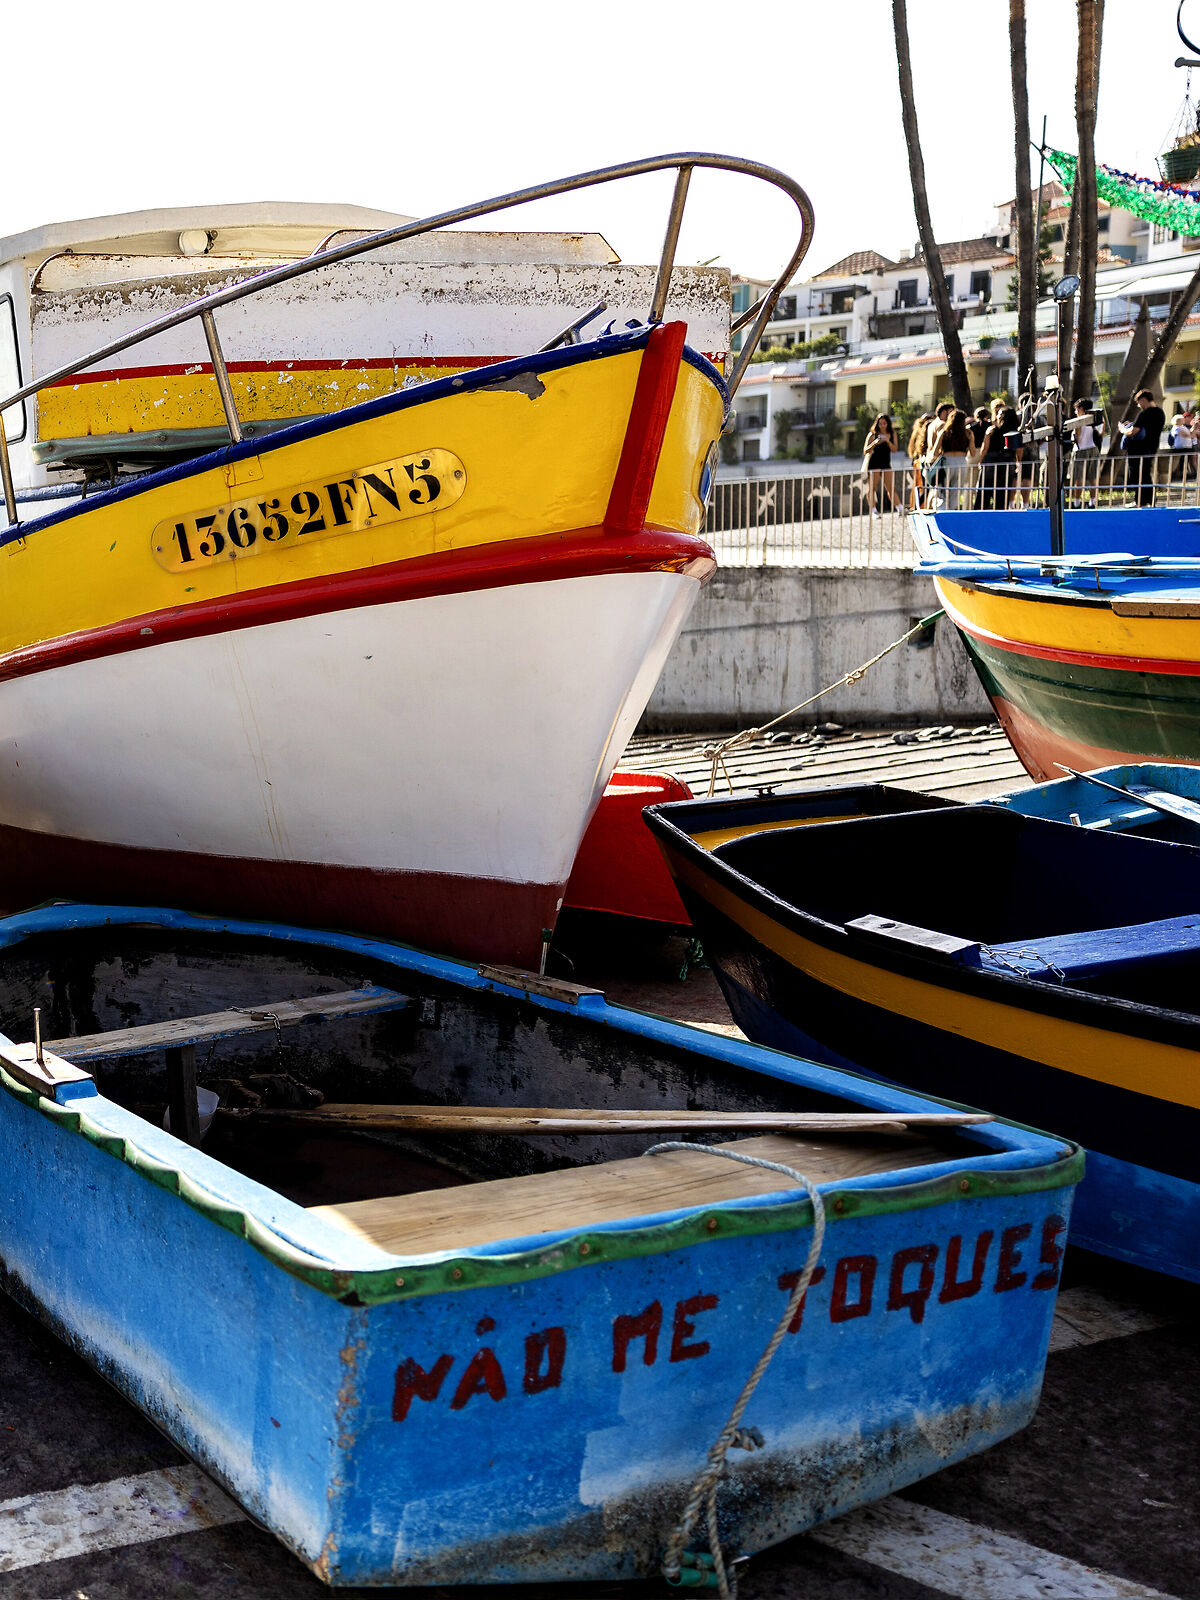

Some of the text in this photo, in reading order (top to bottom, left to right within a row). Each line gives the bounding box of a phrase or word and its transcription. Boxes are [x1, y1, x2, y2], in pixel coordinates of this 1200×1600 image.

[171, 458, 442, 564] 13652FN5
[612, 1294, 719, 1373] ME
[777, 1213, 1067, 1335] TOQUES
